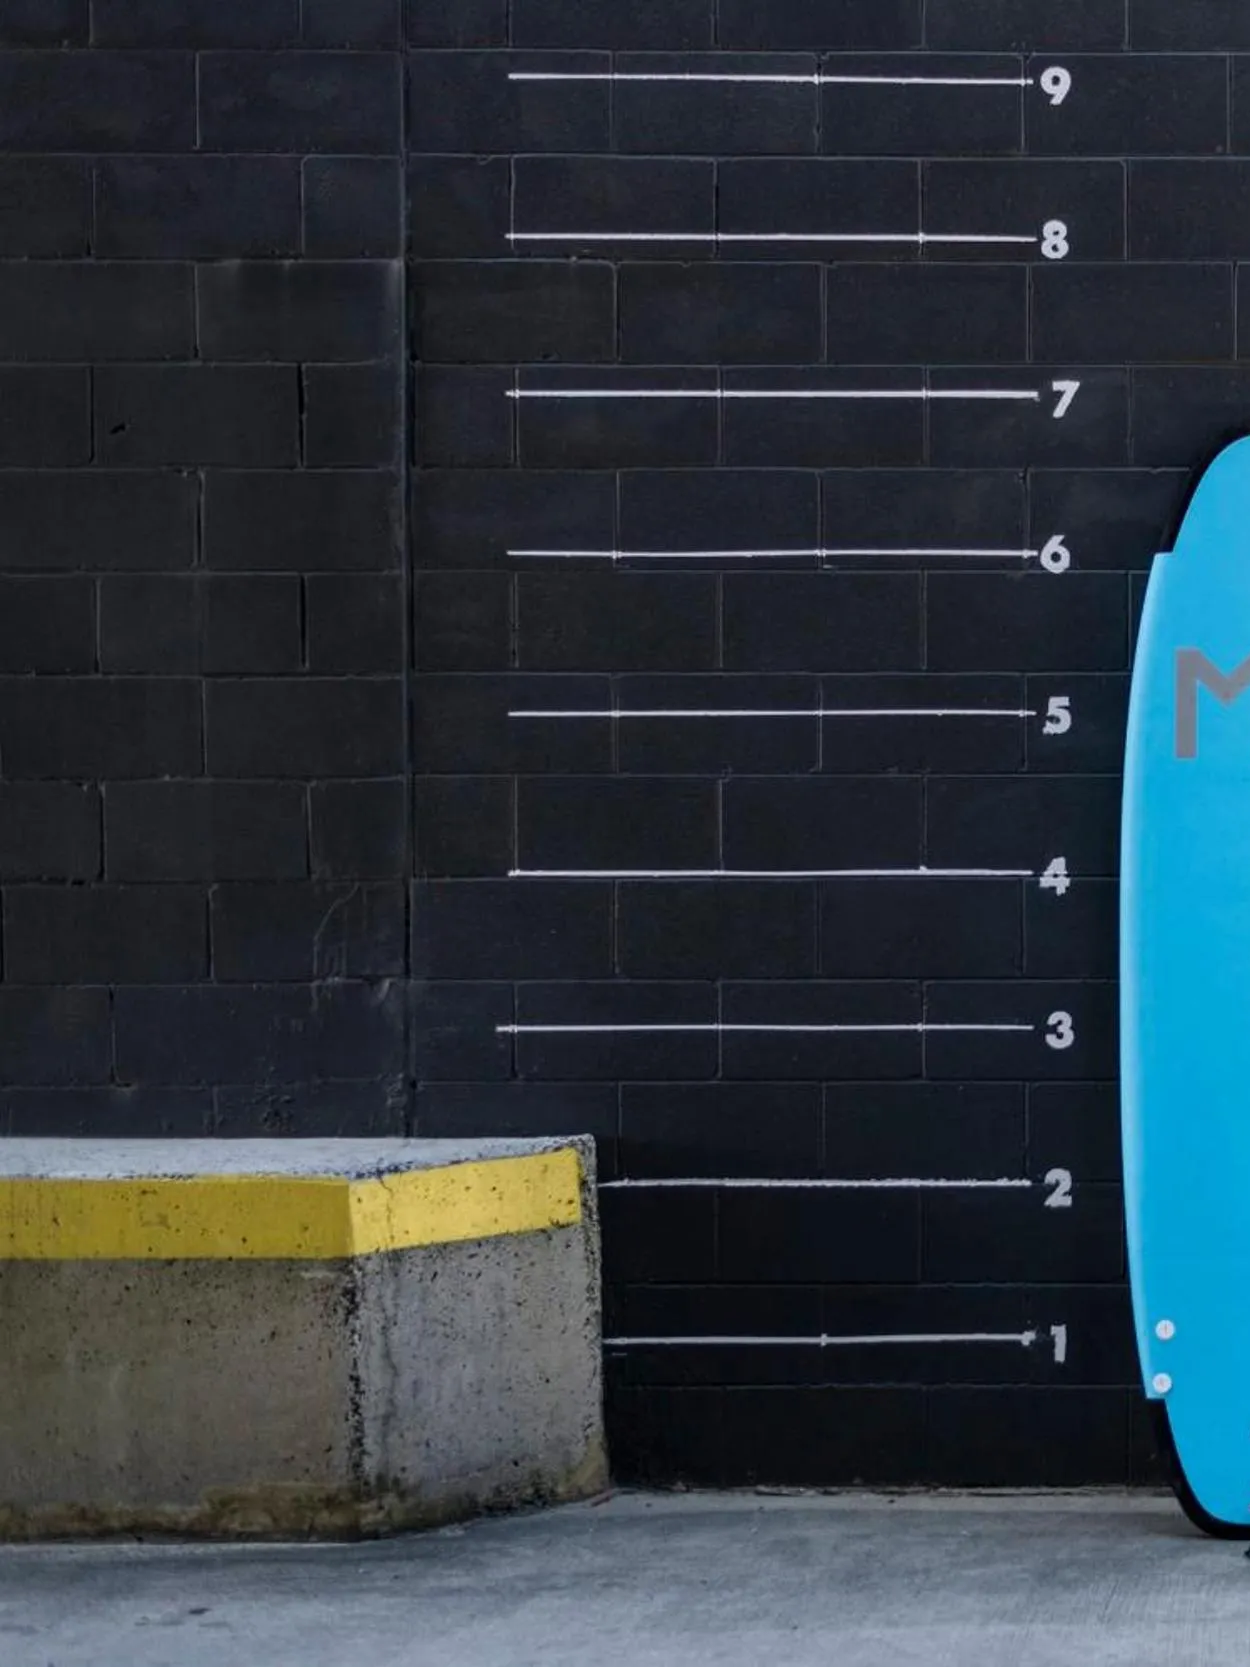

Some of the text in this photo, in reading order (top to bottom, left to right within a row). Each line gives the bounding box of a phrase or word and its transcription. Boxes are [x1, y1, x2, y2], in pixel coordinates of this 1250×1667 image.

[1039, 65, 1072, 106] 9
[1040, 219, 1070, 260] 8
[1051, 379, 1081, 419] 7
[1039, 534, 1071, 575] 6
[1042, 696, 1072, 735] 5
[1039, 856, 1071, 896] 4
[1045, 1011, 1075, 1049] 3
[1044, 1168, 1073, 1208] 2
[1050, 1324, 1067, 1363] 1
